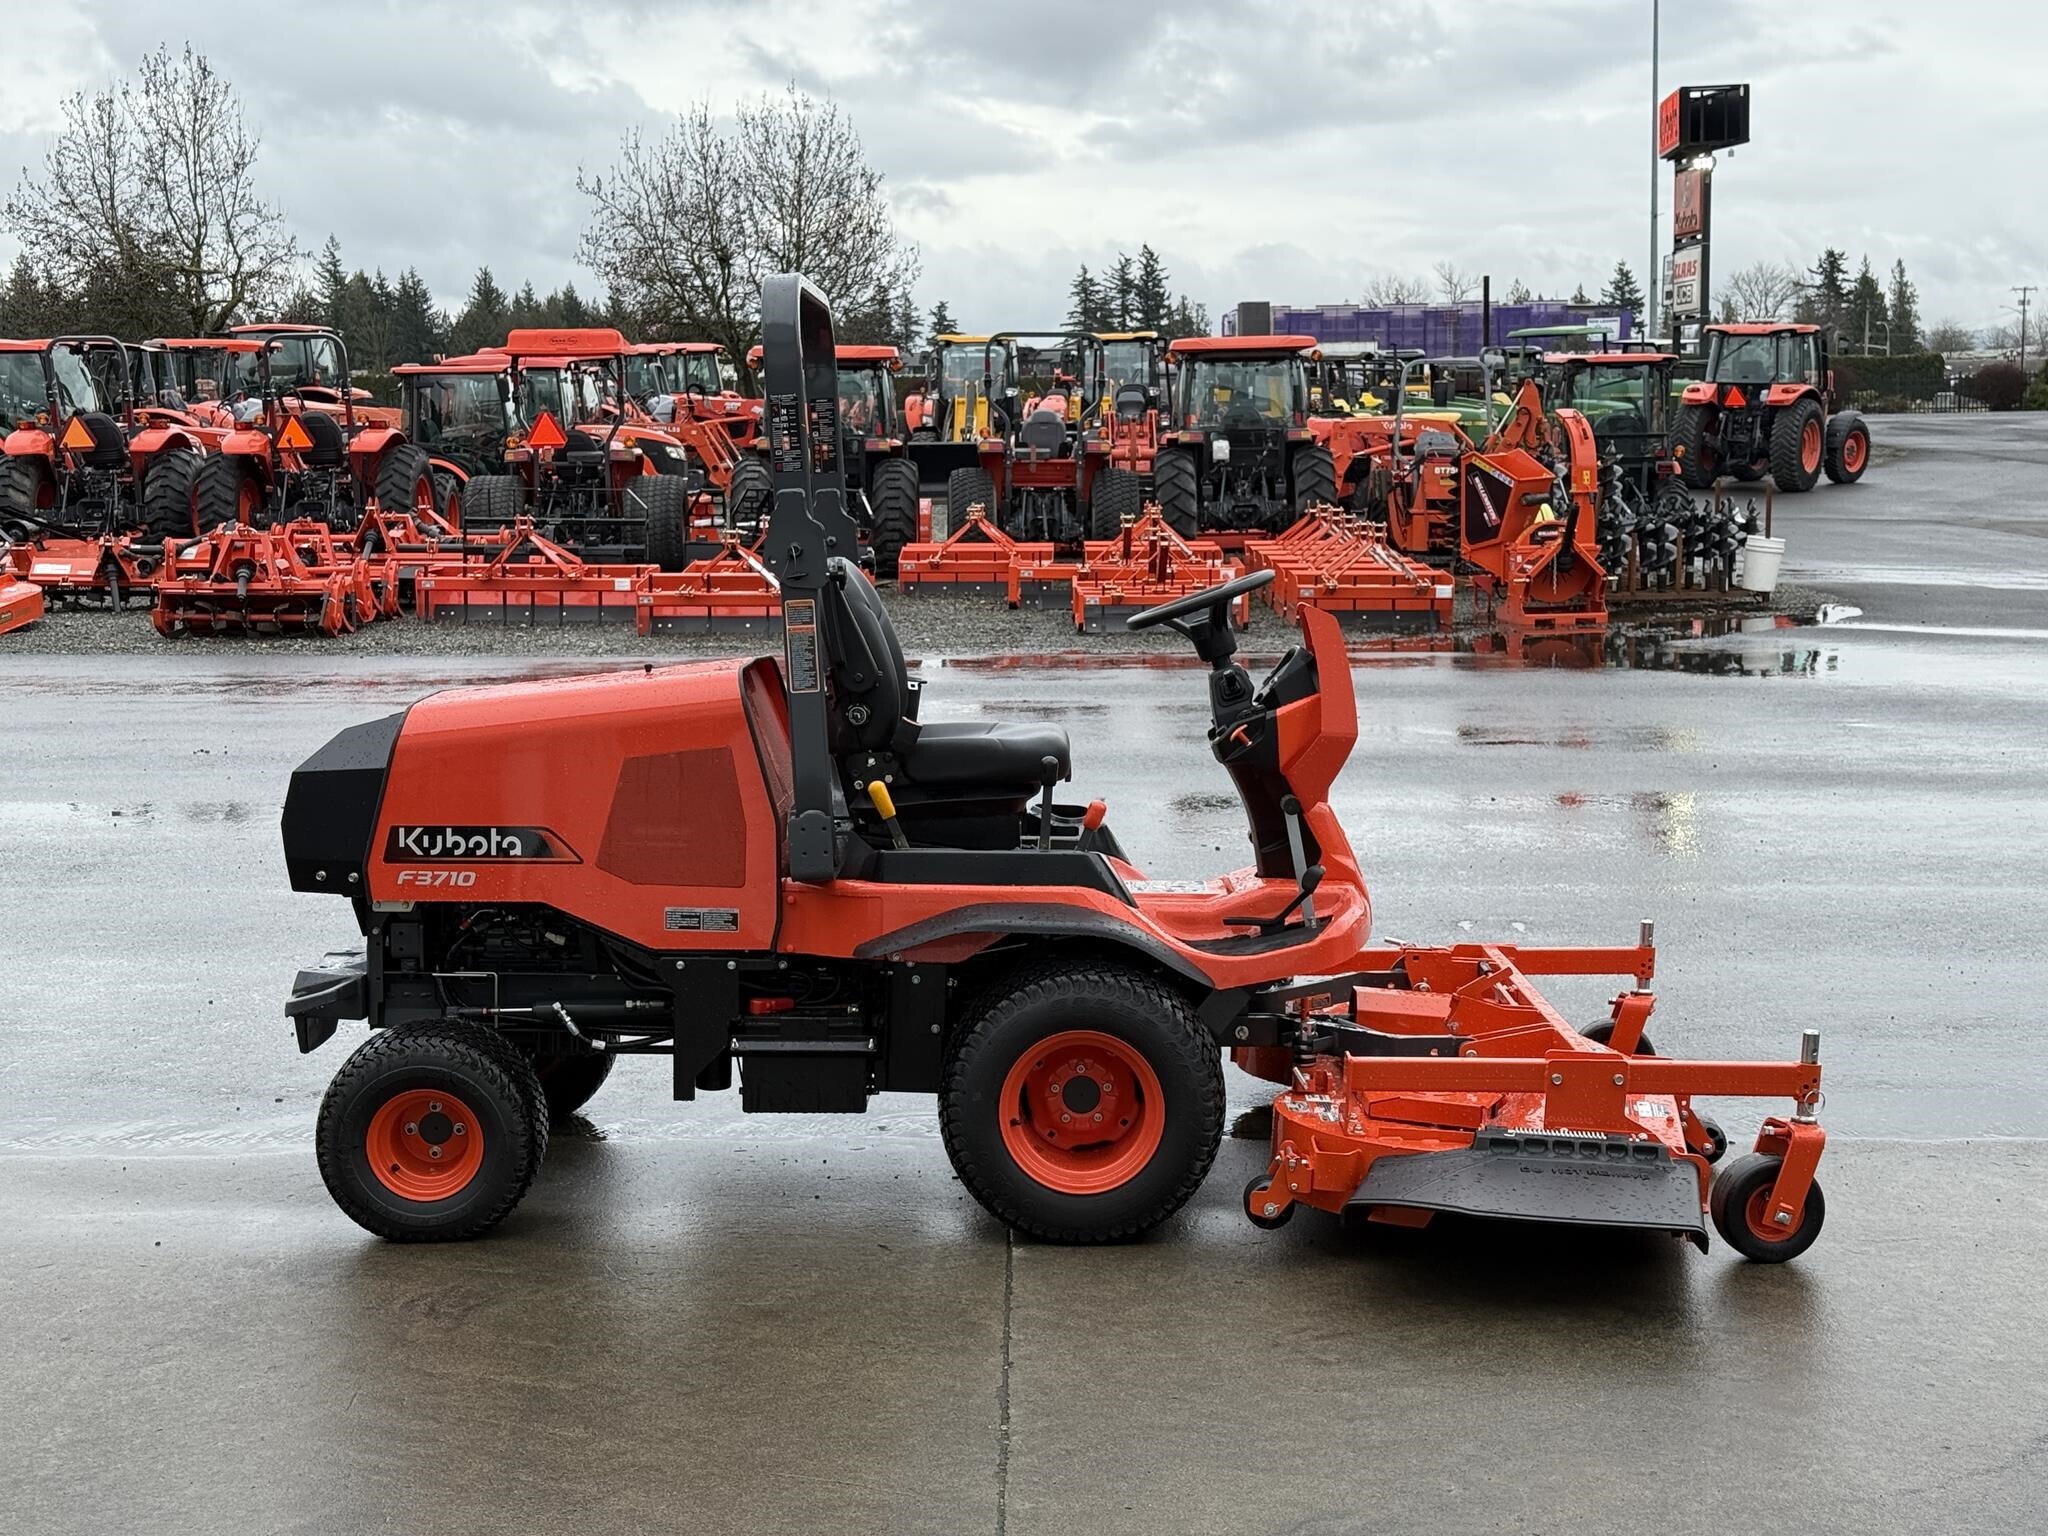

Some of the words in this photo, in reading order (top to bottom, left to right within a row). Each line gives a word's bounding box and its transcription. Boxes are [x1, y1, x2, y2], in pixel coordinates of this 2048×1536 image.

[1674, 260, 1698, 279] CLAAS
[1677, 285, 1693, 304] JCB
[398, 827, 522, 856] Kubota
[397, 870, 477, 887] F3710
